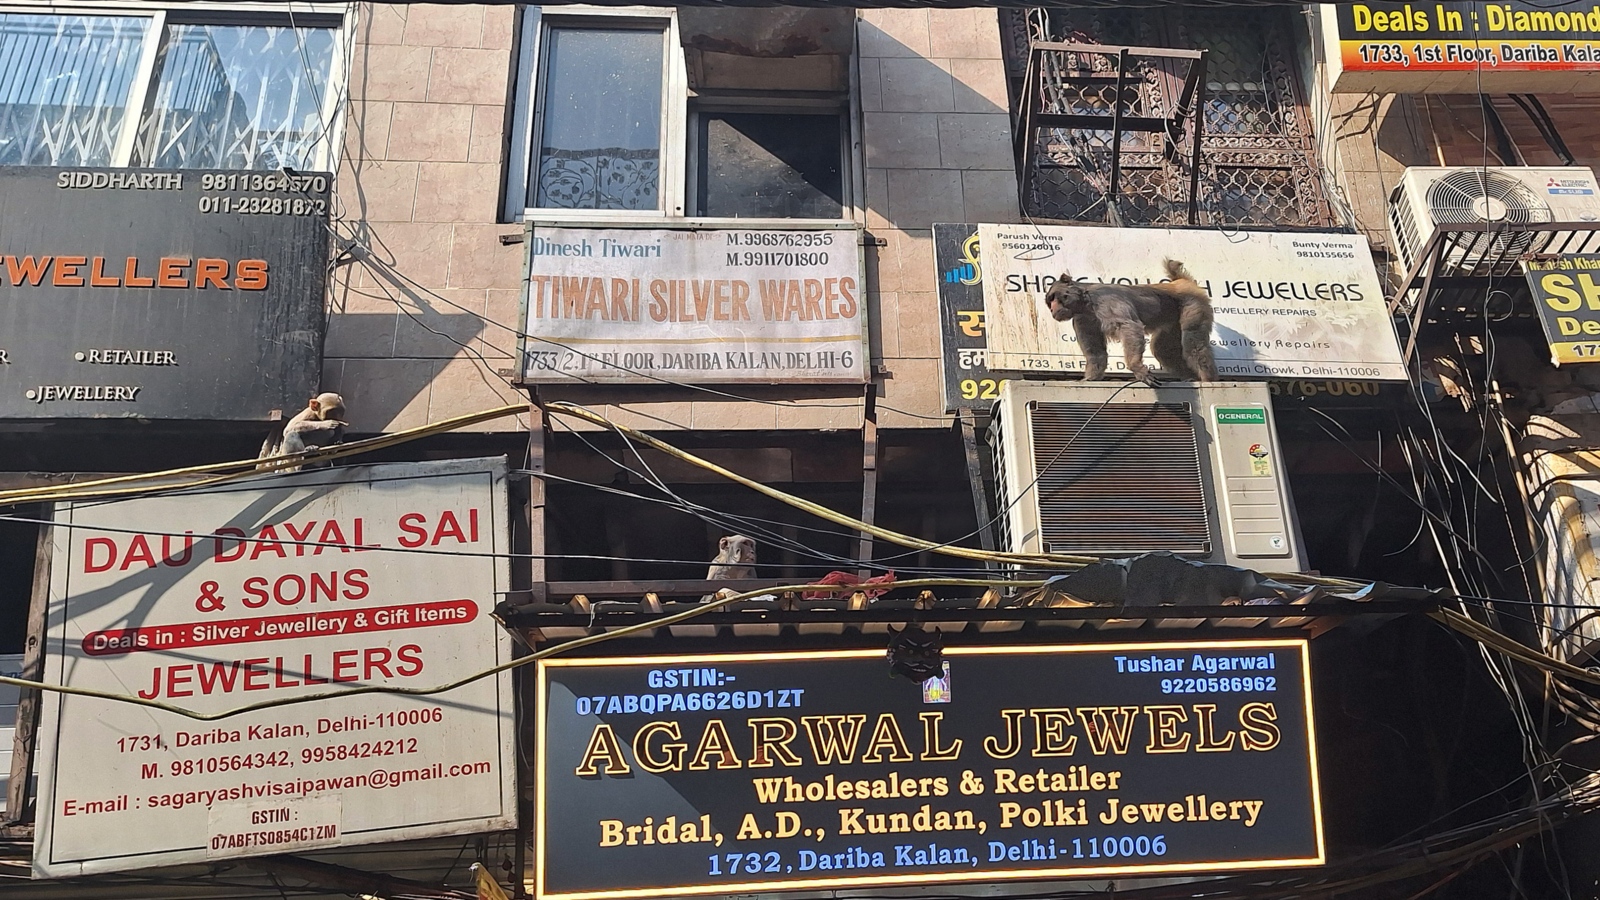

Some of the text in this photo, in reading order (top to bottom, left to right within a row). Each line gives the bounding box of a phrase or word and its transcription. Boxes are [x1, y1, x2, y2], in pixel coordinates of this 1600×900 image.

[1353, 5, 1429, 32] Deals
[1436, 6, 1463, 32] In
[1359, 44, 1410, 66] 1733,
[1414, 44, 1442, 63] 1st
[1447, 44, 1497, 66] Floor,
[1502, 44, 1559, 63] Dariba
[57, 172, 183, 190] SIDDHARTH
[201, 173, 327, 192] 9811364570
[199, 196, 326, 216] 011-23281872
[533, 237, 661, 257] Dinesh Tiwari
[726, 233, 834, 247] M.9968762955
[1292, 241, 1320, 249] Bunty
[726, 251, 829, 266] M.9911701800
[0, 256, 269, 289] WELLERS
[532, 275, 858, 323] TIWARI SILVER WARES
[1222, 281, 1364, 301] JEWELLERS
[1213, 306, 1317, 317] EWELLERY REPAIRS
[1209, 339, 1331, 350] ewellery Repairs
[89, 350, 177, 366] RETAILER
[1020, 359, 1053, 369] 1733,
[1058, 360, 1076, 369] 1st
[1254, 365, 1299, 376] Chowk,
[1302, 366, 1381, 377] Delhi-110006
[36, 386, 139, 403] JEWELLERY
[84, 509, 479, 574] DAU DAYAL SAI
[195, 569, 371, 613] & SONS
[93, 632, 150, 651] Deals
[155, 629, 174, 645] in
[192, 624, 249, 643] Silver
[254, 615, 348, 637] Jewellery
[353, 613, 369, 628] &
[374, 608, 410, 627] Gift
[415, 604, 467, 621] Items
[138, 644, 424, 700] JEWELLERS
[1114, 653, 1276, 673] Tushar Agarwal
[648, 669, 736, 688] GSTIN:-
[1161, 677, 1277, 694] 9220586962
[116, 707, 443, 753] 1731, Dariba Kalan, Delhi-110006
[575, 702, 1281, 776] AGARWAL JEWELS
[141, 738, 418, 780] M. 9810564342, 9958424212
[63, 795, 128, 817] E-mail
[147, 759, 491, 808] sagaryashvisaipawan@gmail.com
[753, 765, 1121, 804] Wholesalers & Retailer
[251, 808, 290, 825] GSTIN
[599, 795, 1263, 847] Bridal, A.D., Kundan, Polki Jewellery
[799, 846, 886, 872] Dariba
[894, 841, 978, 868] Kalan,
[988, 835, 1167, 863] Delhi-110006
